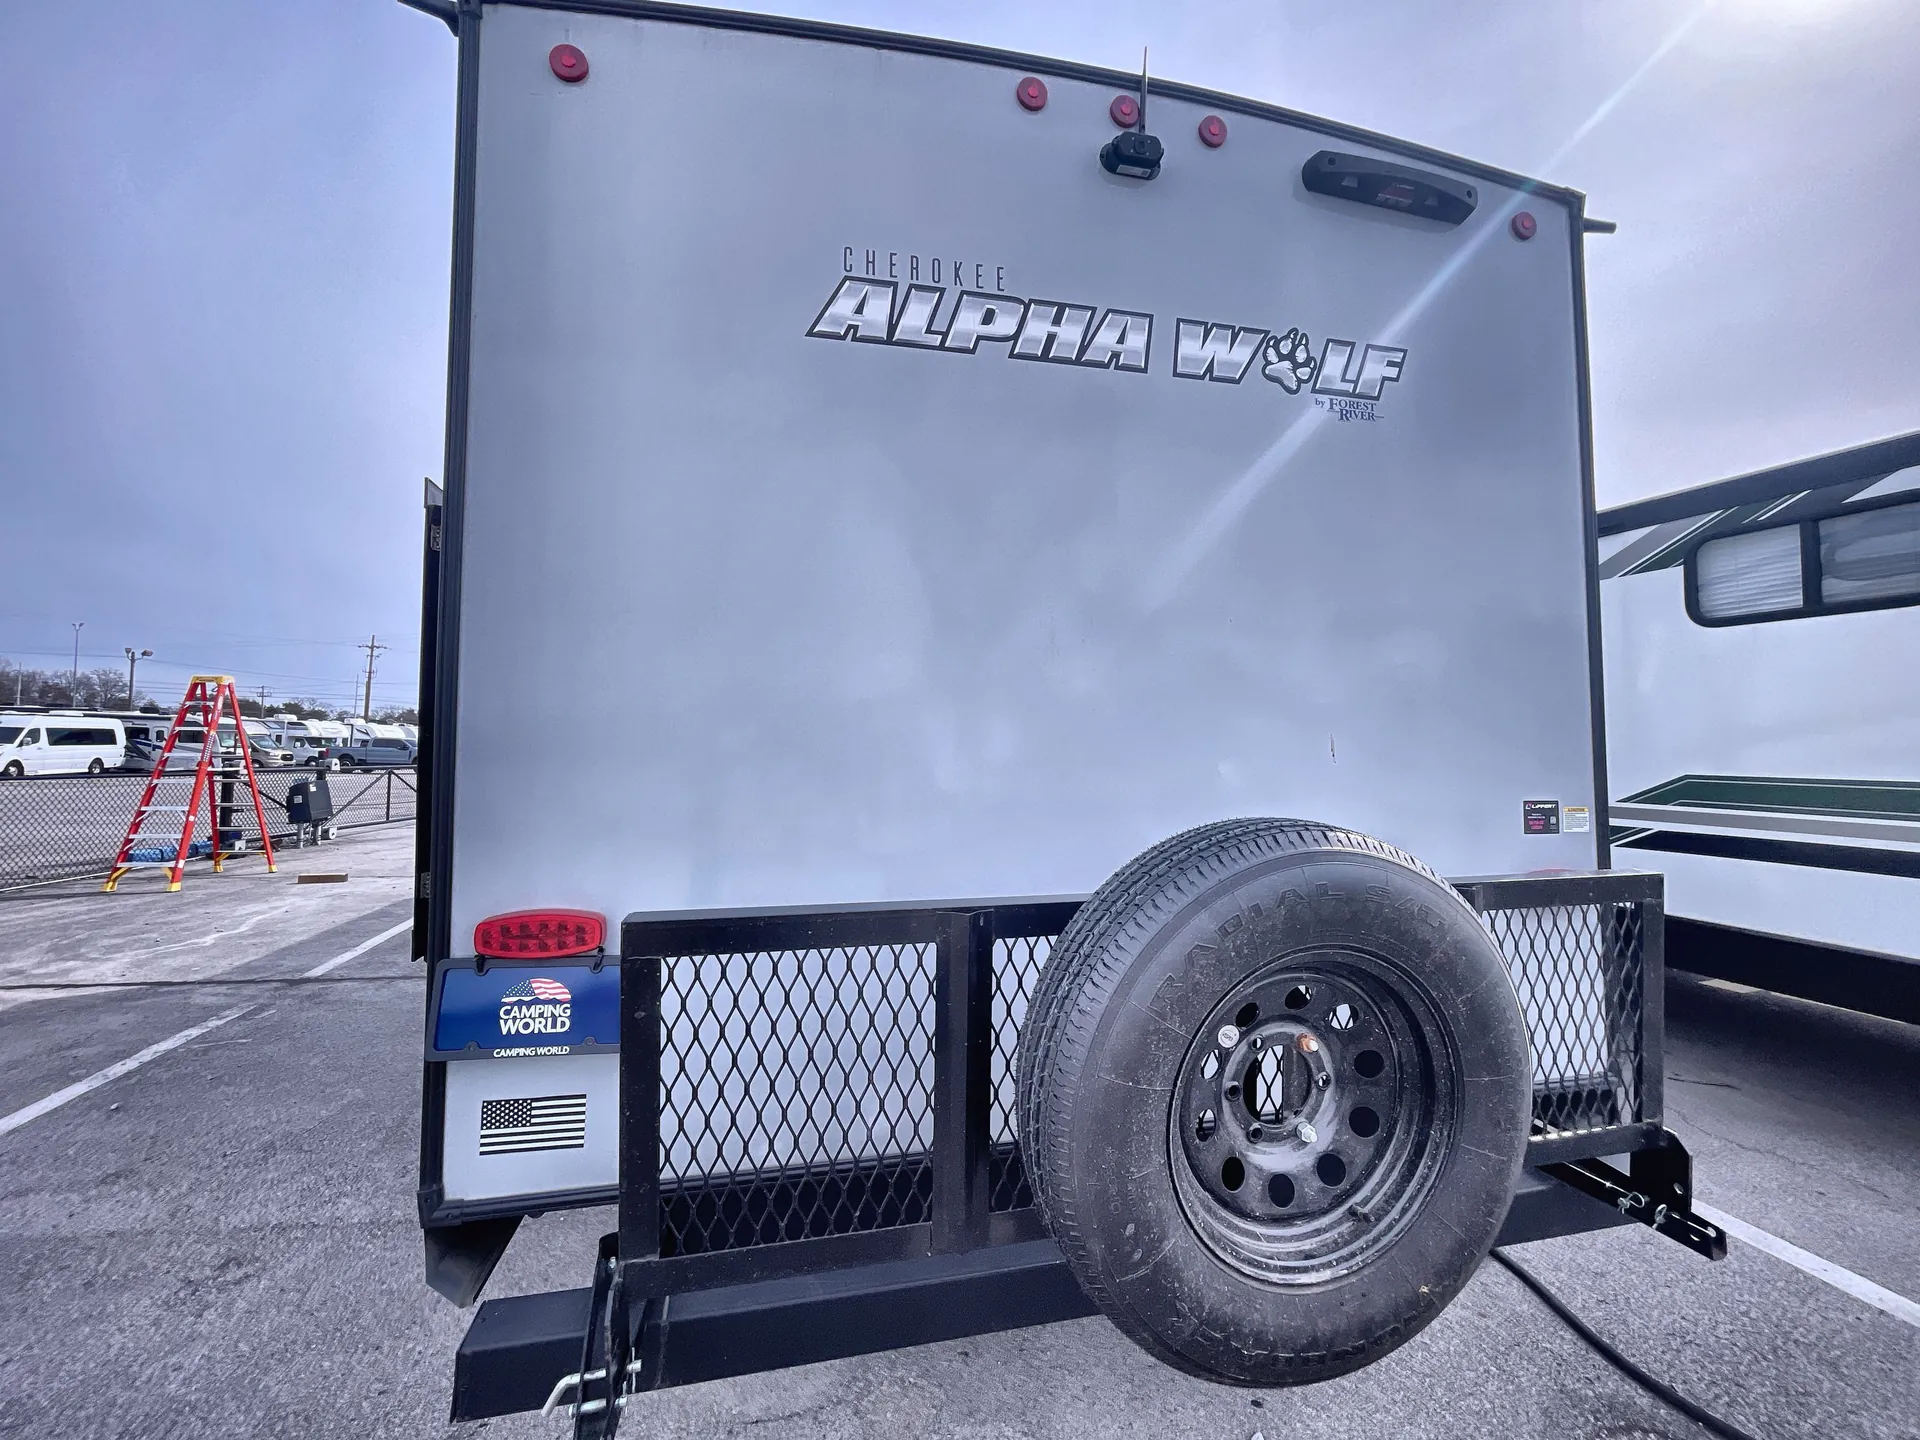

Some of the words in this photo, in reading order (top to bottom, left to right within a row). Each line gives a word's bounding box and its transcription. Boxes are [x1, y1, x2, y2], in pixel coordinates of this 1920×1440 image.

[842, 245, 1006, 292] CHEROKEE
[804, 275, 1155, 374] ALPHA
[1315, 398, 1326, 408] by
[1328, 398, 1377, 412] FOREST
[1338, 408, 1376, 421] RIVER
[499, 1003, 571, 1020] CAMPING
[499, 1016, 571, 1035] WORLD
[493, 1047, 536, 1058] CAMPING
[536, 1046, 570, 1056] WORLD
